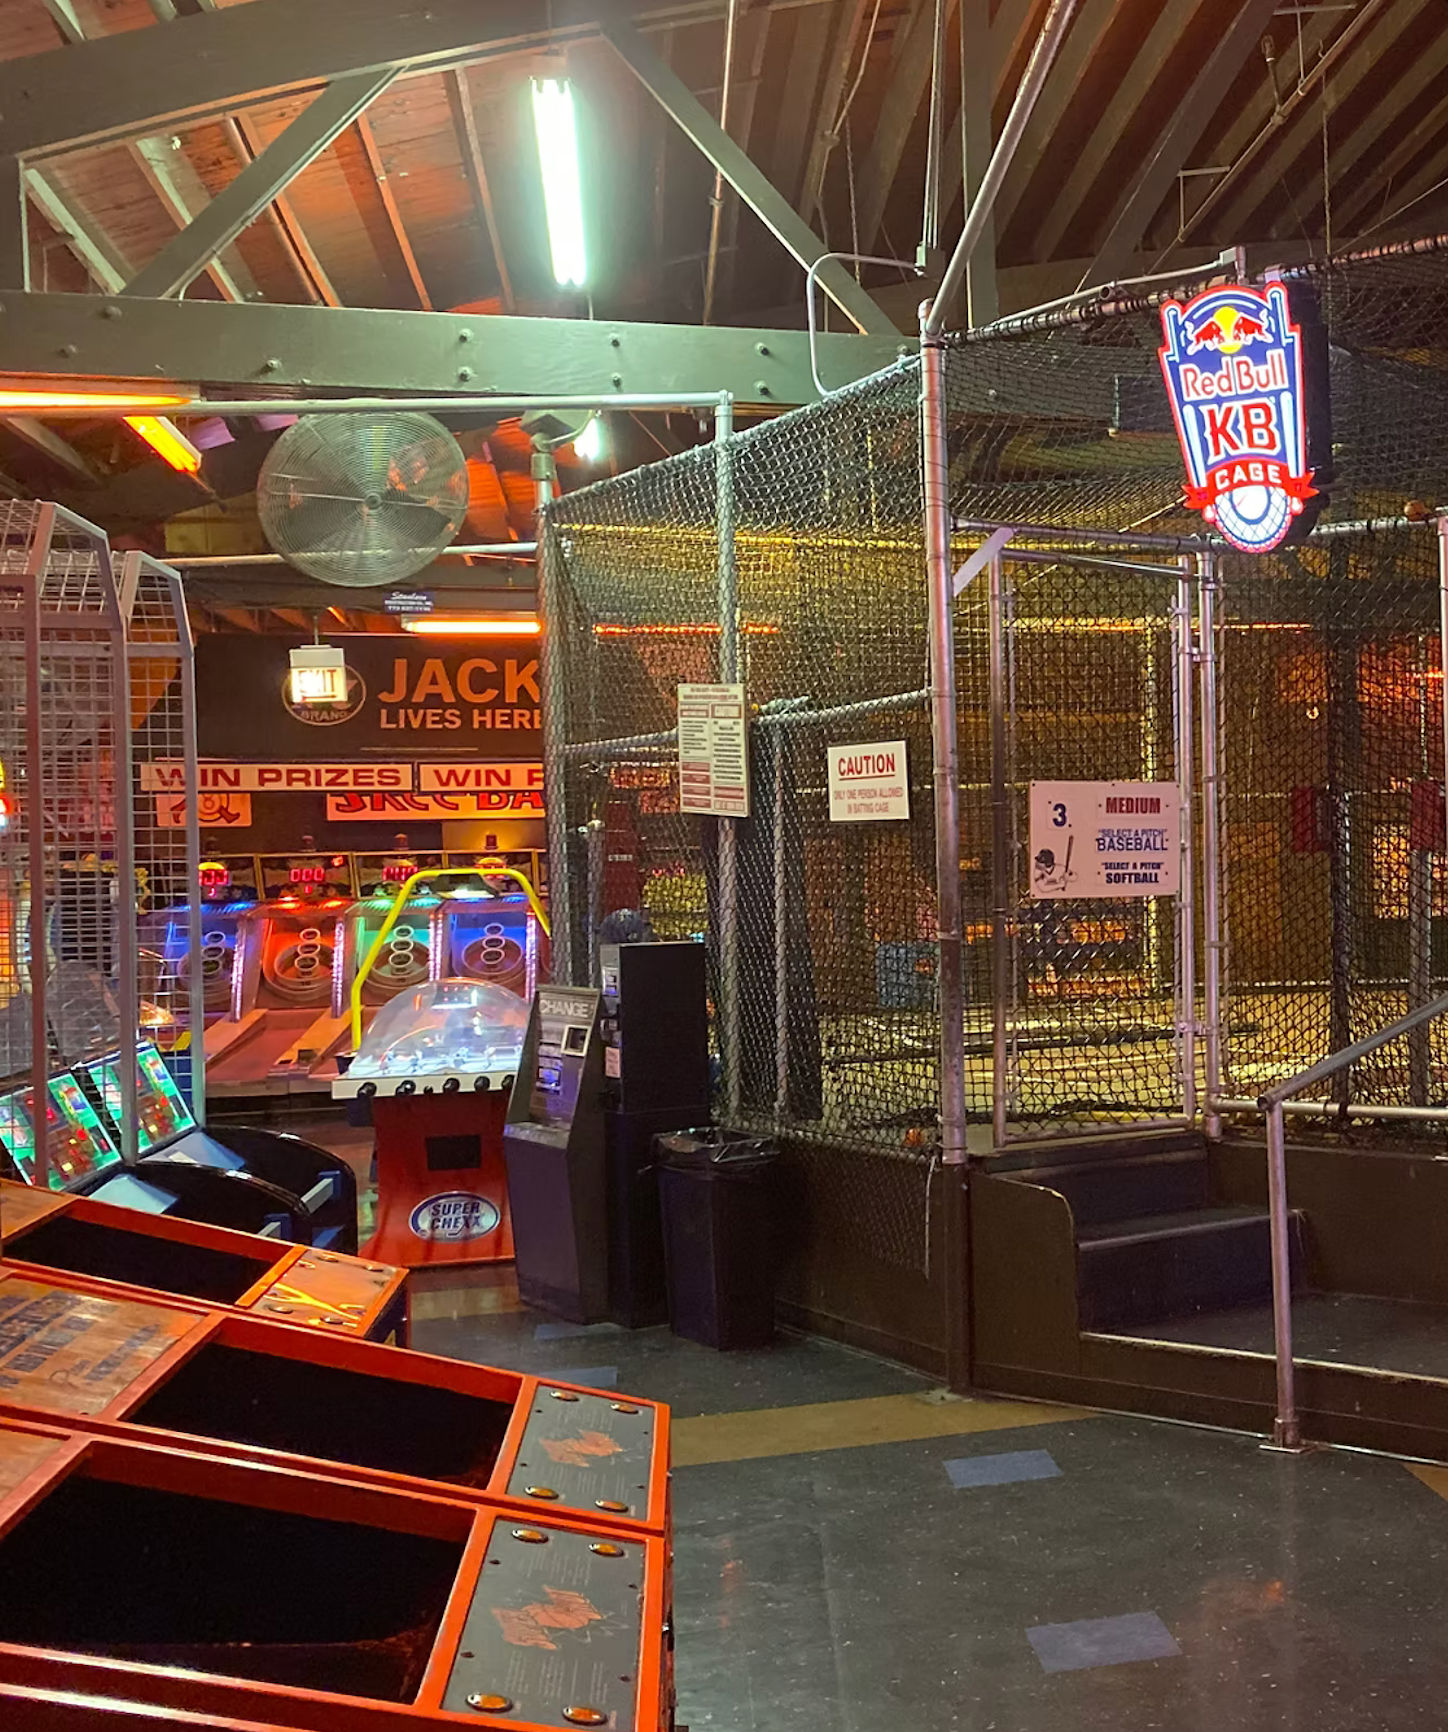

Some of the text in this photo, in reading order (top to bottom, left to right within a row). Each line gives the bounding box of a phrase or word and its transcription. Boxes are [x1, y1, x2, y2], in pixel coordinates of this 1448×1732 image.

[1182, 350, 1288, 399] Red Bull
[1203, 399, 1279, 461] KB
[1215, 464, 1282, 491] CAGE
[377, 658, 540, 703] JACK
[380, 709, 461, 729] LIVES
[838, 753, 895, 776] CAUTION
[155, 769, 401, 787] WIN PRIZES
[433, 769, 511, 787] WIN
[1052, 803, 1067, 827] 3
[1105, 797, 1161, 814] MEDIUM
[1097, 837, 1168, 851] BASEBALL
[1106, 872, 1159, 884] SOFTBALL
[432, 1202, 480, 1216] SUPER
[431, 1213, 480, 1230] CHEXX
